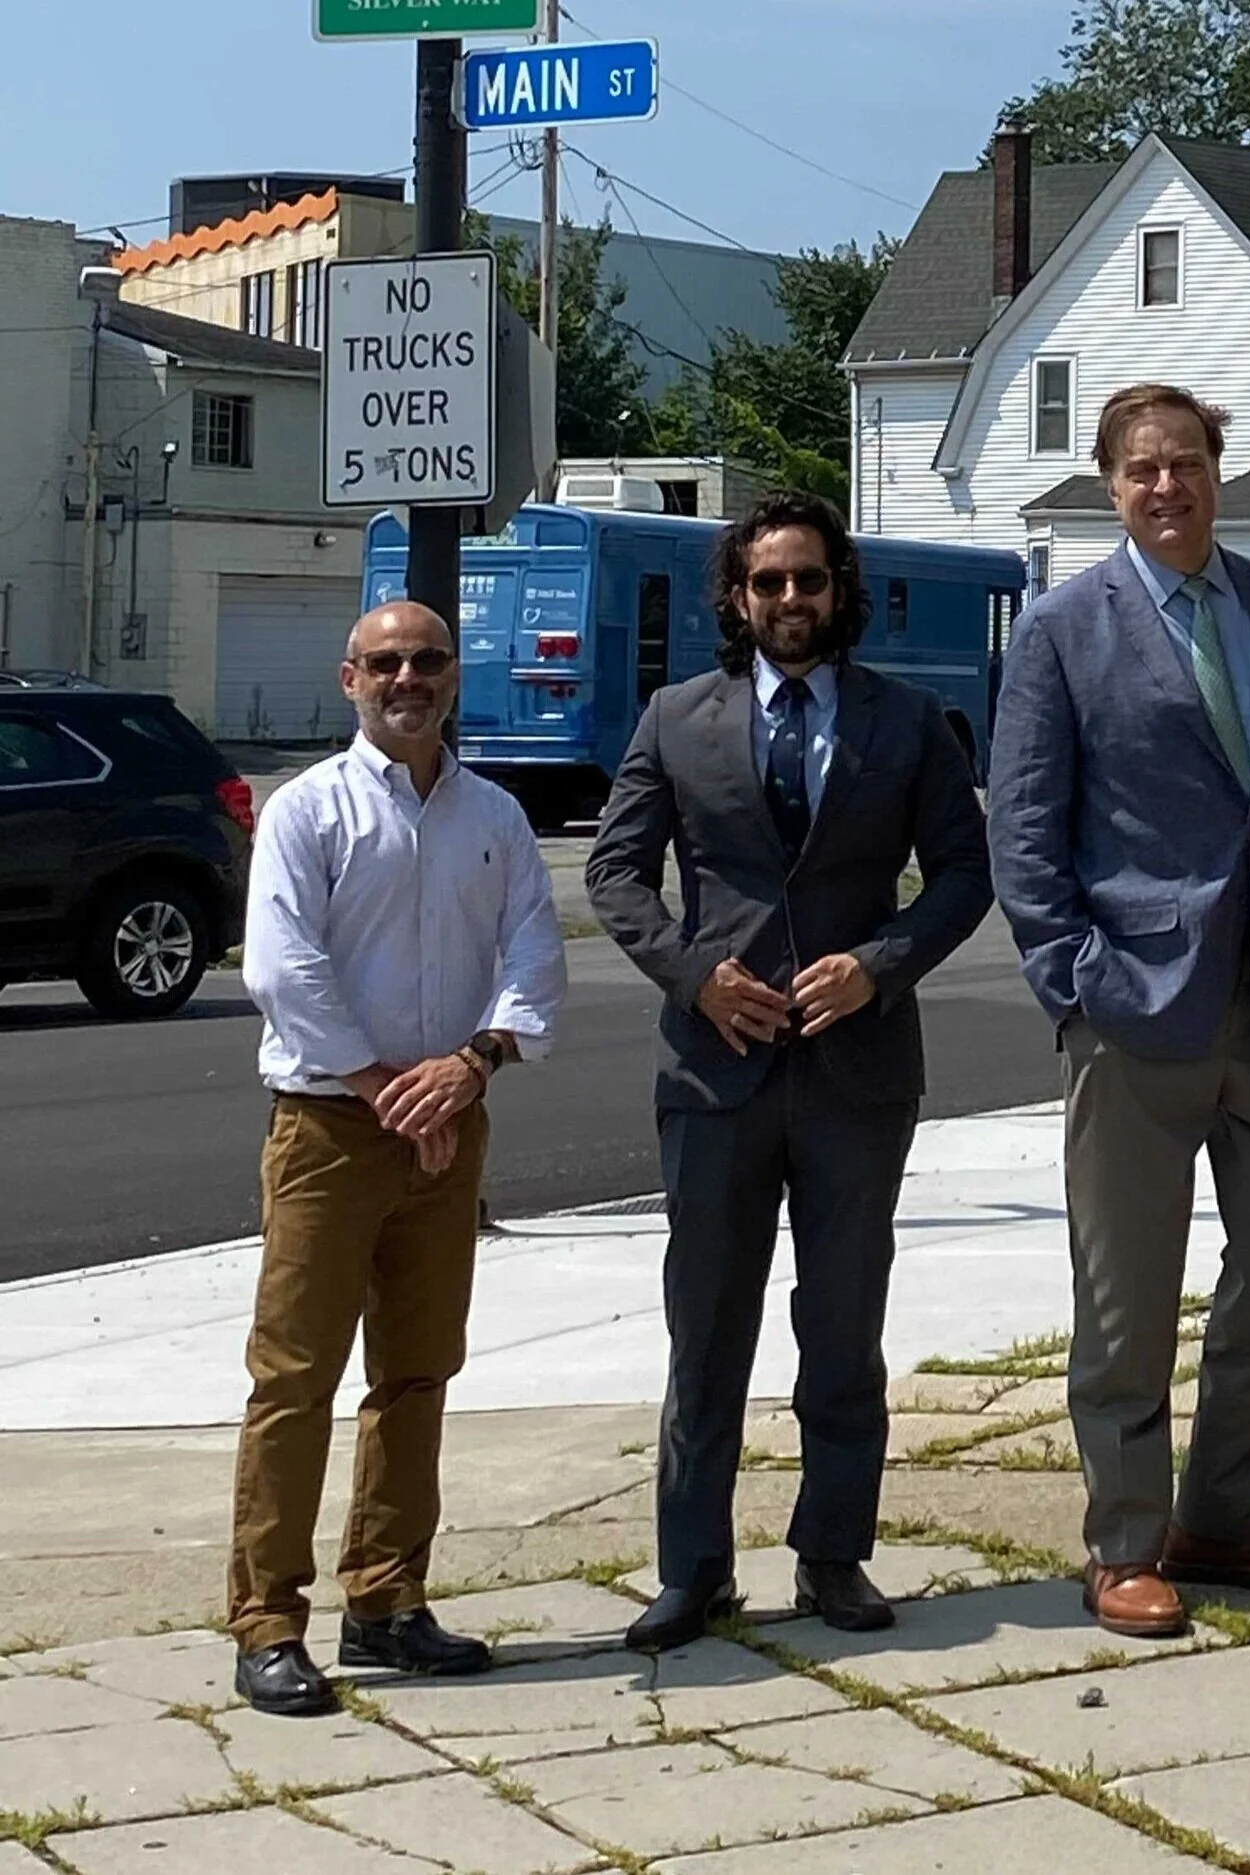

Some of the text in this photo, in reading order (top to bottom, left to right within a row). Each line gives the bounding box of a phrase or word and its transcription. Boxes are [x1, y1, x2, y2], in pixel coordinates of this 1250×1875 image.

[477, 58, 635, 117] MAIN ST
[385, 276, 432, 314] NO
[342, 331, 475, 372] TRUCKS
[362, 389, 449, 428] OVER
[342, 444, 475, 486] 5 TONS
